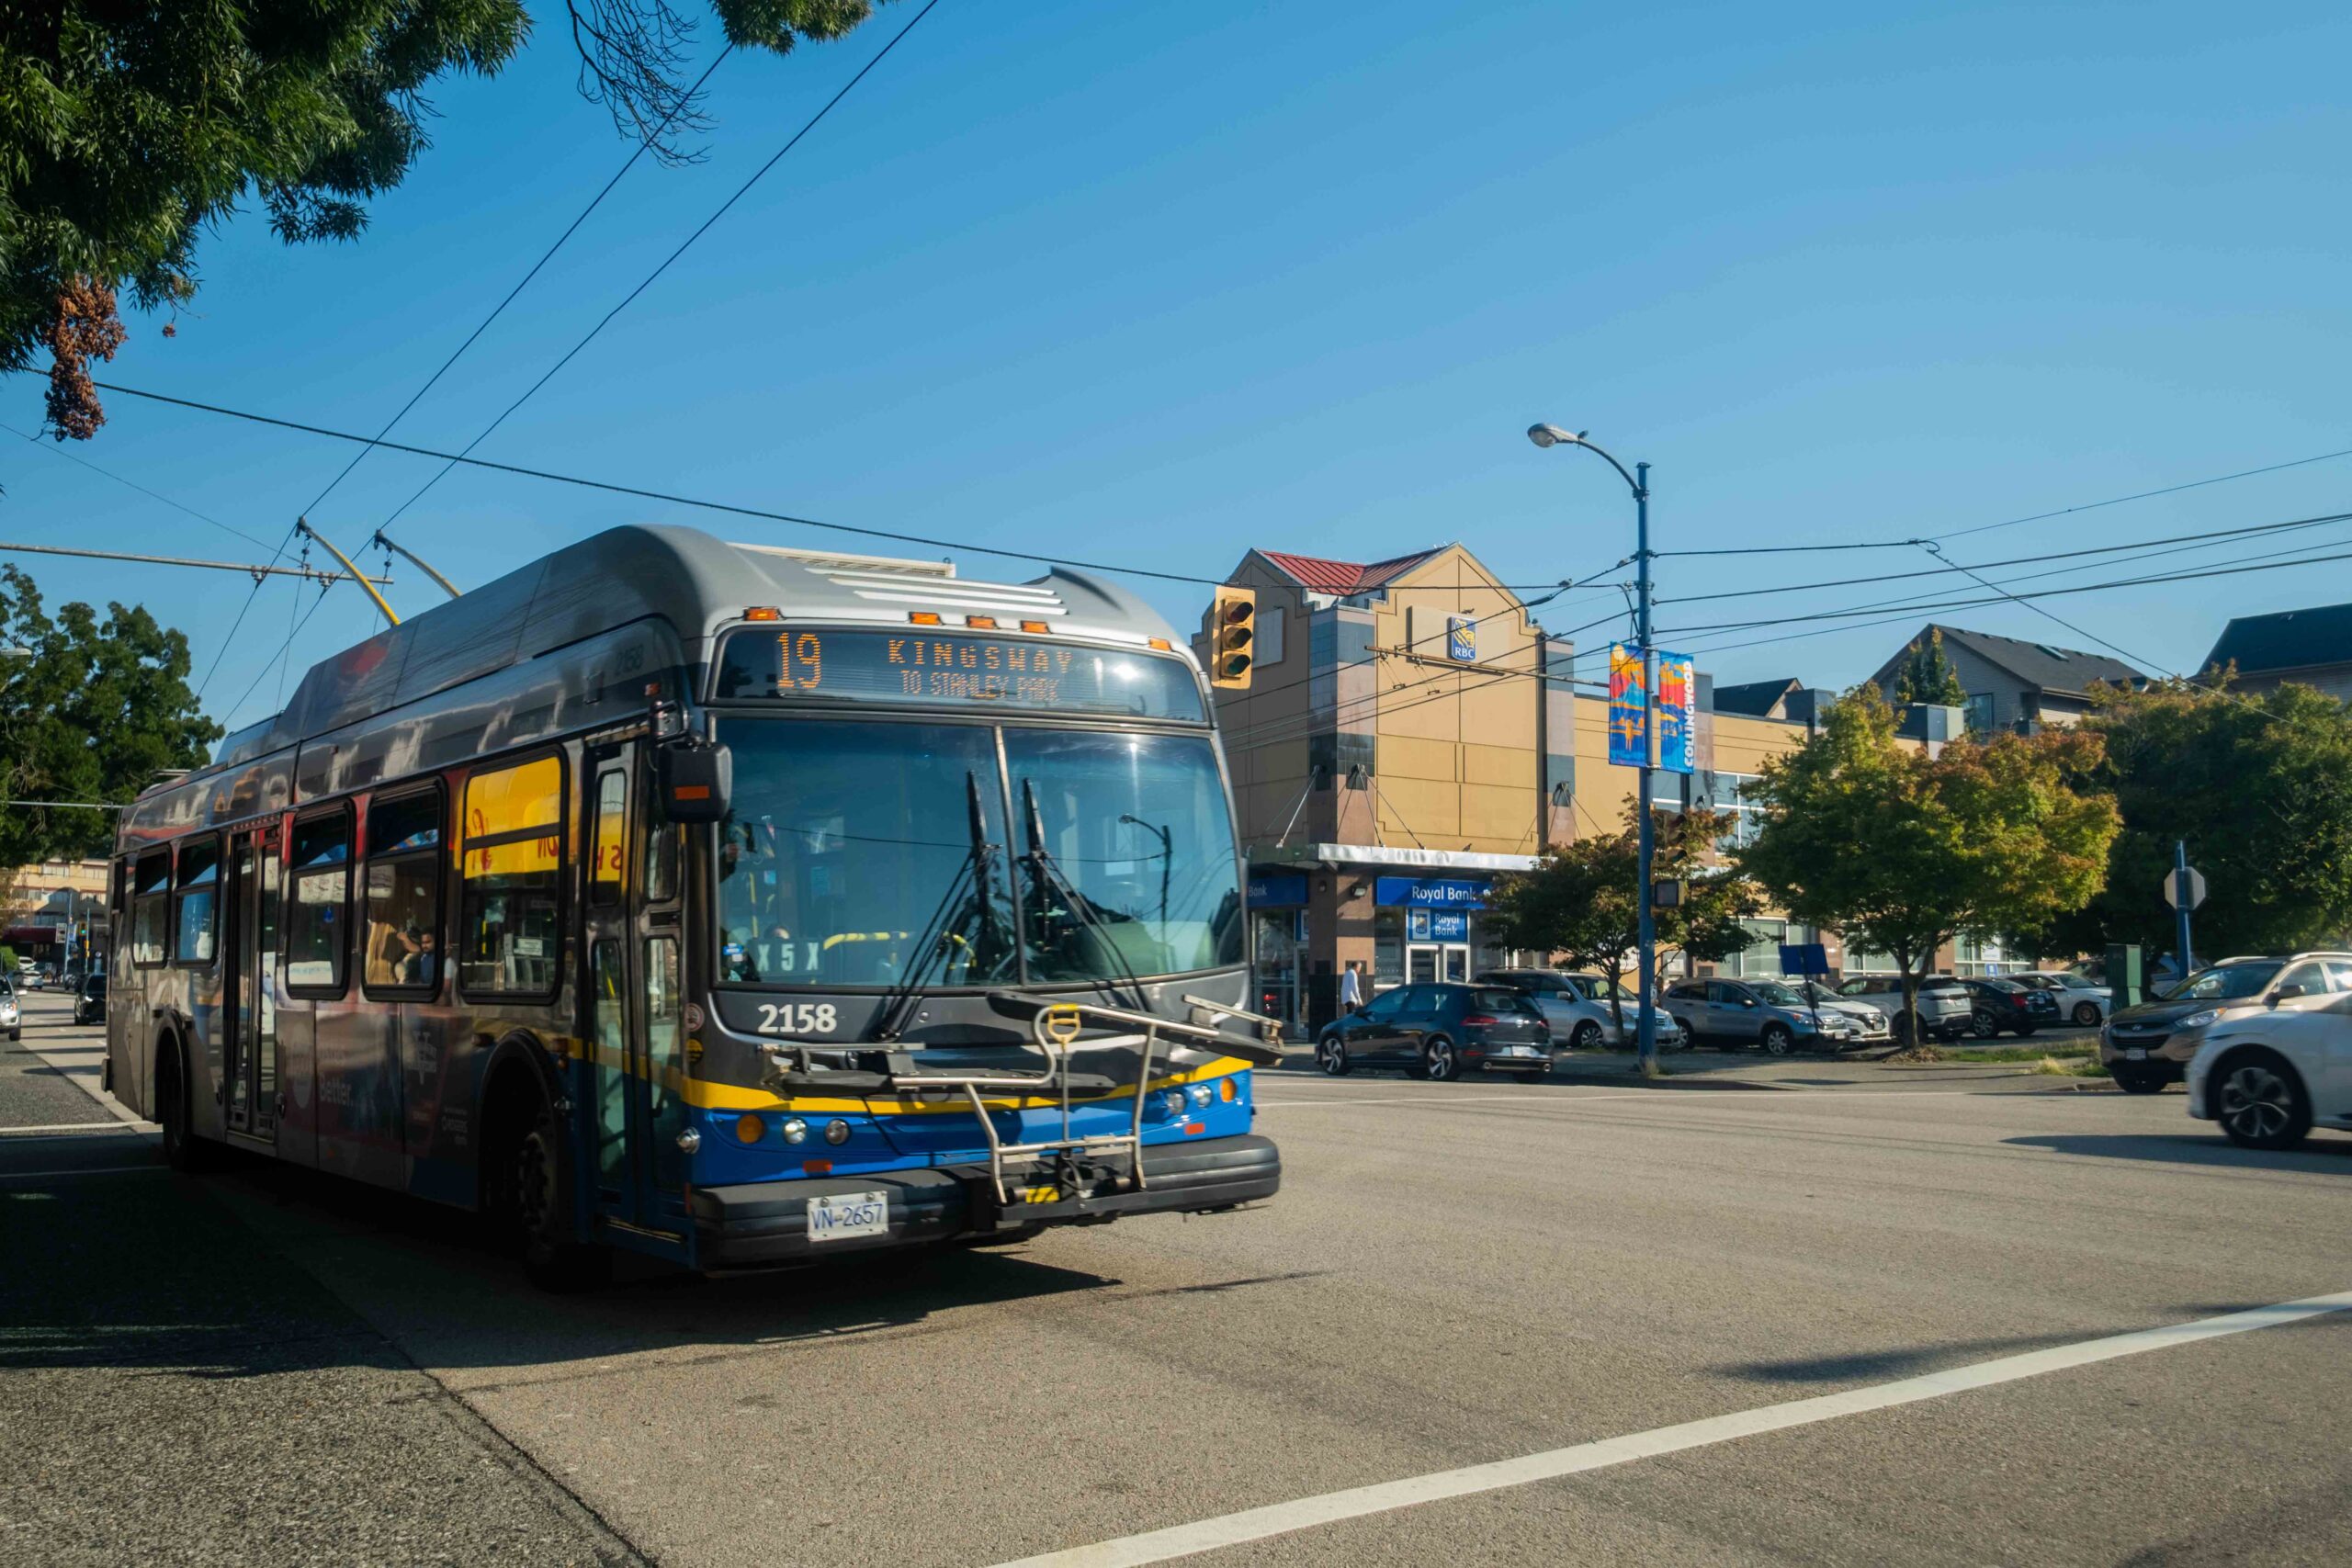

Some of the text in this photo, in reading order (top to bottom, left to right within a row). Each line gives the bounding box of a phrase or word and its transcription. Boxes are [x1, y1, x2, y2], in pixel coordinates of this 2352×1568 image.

[777, 632, 821, 689] 19
[888, 638, 1074, 674] KINGSWAY
[1454, 647, 1475, 659] RBC
[900, 670, 922, 694] TO
[930, 671, 1009, 699] STANLEY
[1682, 660, 1694, 767] COLLINGWOOD
[1412, 885, 1444, 904] Royal
[1434, 912, 1460, 927] Royal
[1434, 925, 1458, 936] Bank
[757, 1003, 838, 1033] 2158
